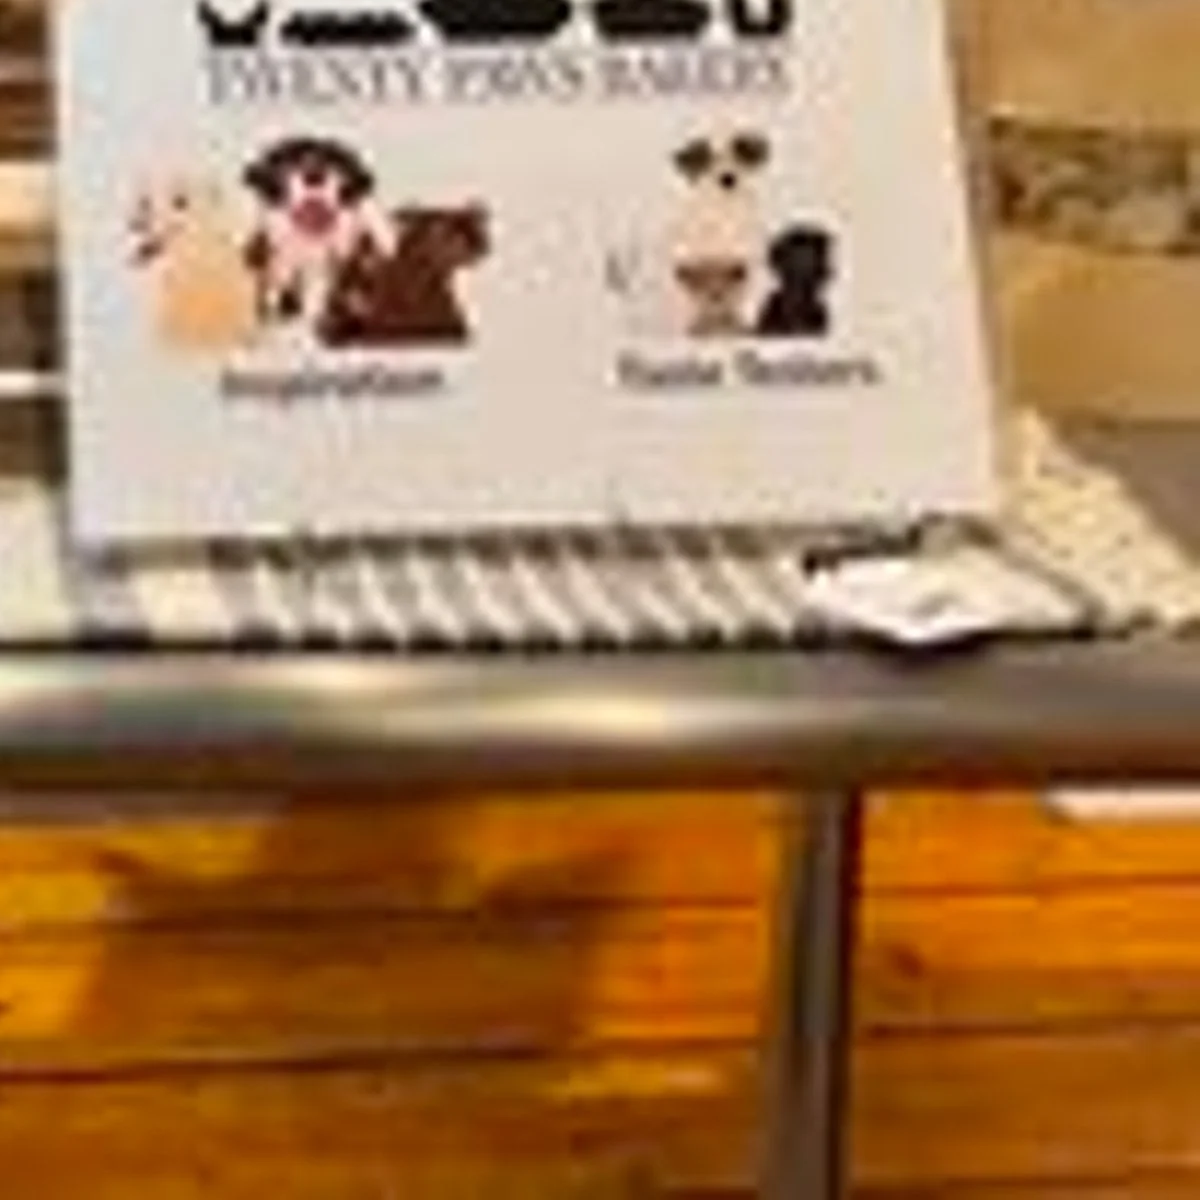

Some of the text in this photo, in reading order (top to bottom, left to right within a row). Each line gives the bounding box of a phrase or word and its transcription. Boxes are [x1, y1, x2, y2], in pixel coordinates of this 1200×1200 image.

[207, 50, 790, 104] TWENTY PAWS BAKERY
[220, 362, 446, 402] Inspiration
